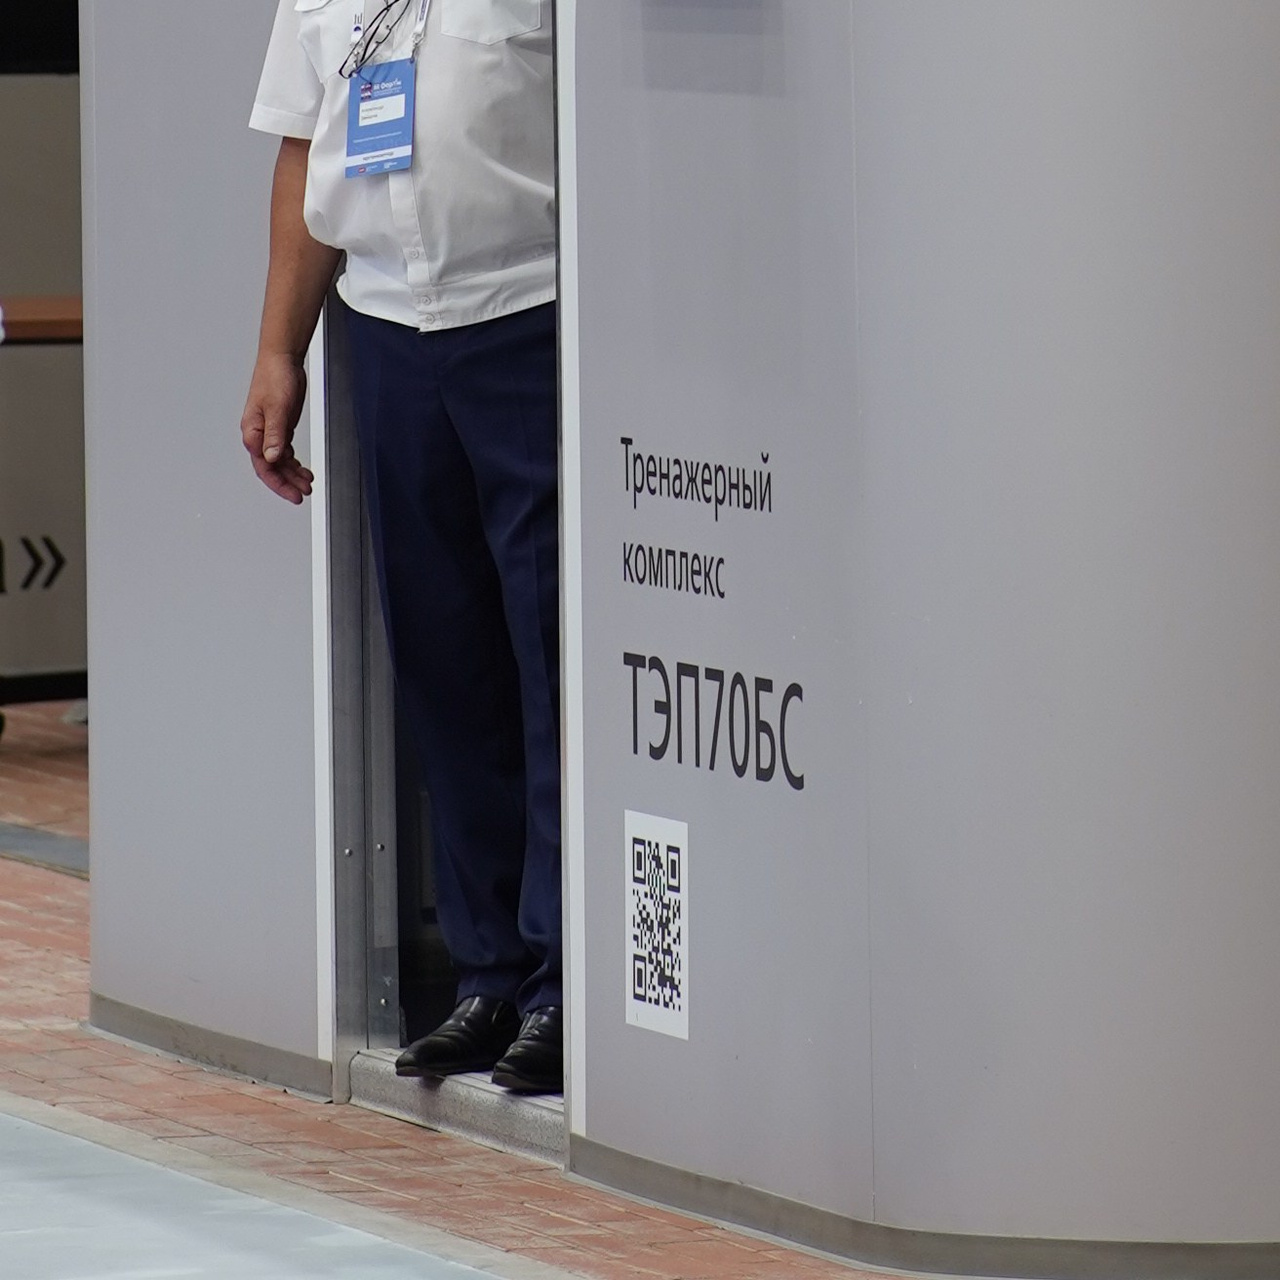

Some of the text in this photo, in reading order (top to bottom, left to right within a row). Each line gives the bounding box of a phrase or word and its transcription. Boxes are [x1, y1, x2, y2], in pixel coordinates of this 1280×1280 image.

[620, 436, 772, 522] Тренажерный
[623, 541, 726, 599] комплекс
[623, 651, 805, 791] ТЭП70БС
